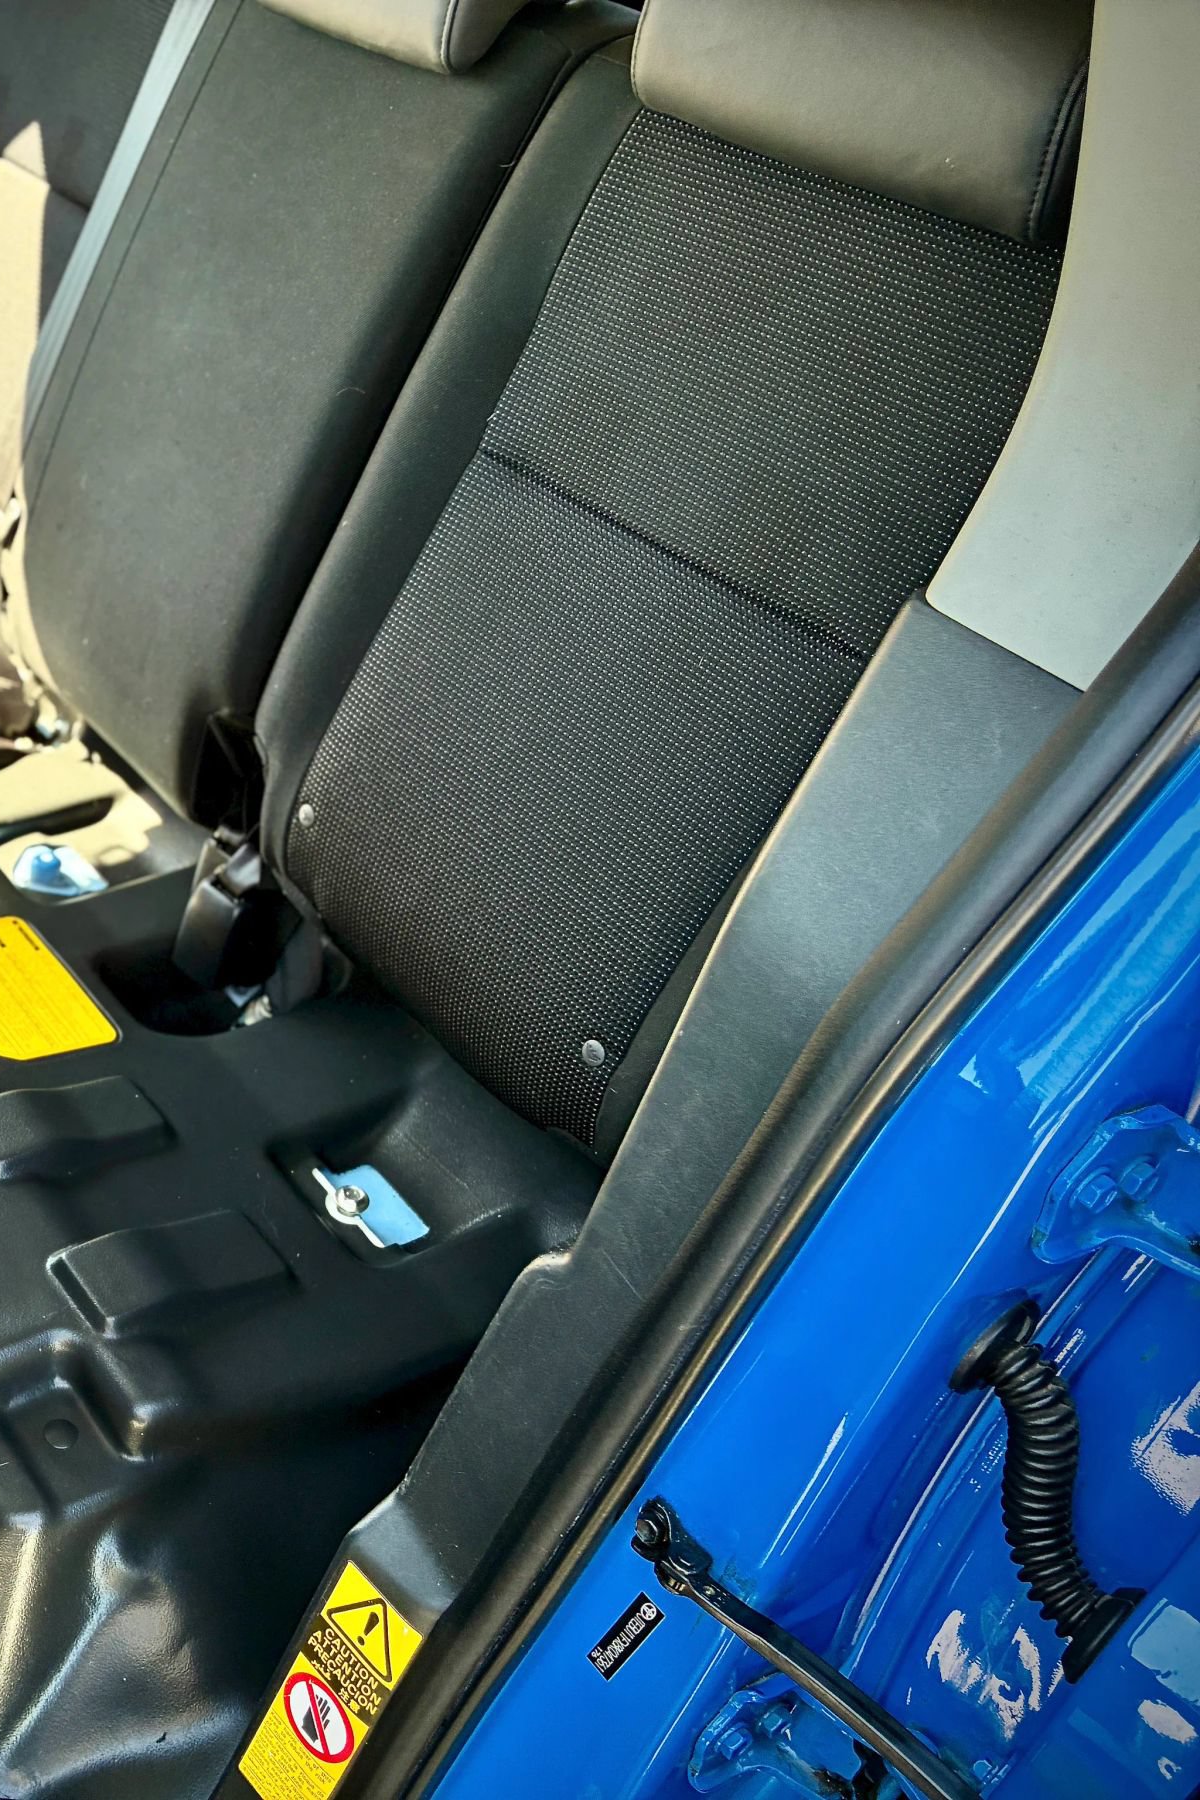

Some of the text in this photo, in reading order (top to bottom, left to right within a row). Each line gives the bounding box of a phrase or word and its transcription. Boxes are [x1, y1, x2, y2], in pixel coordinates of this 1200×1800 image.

[307, 1636, 378, 1715] PRECAUCION
[313, 1630, 382, 1706] ATTENTION
[325, 1628, 379, 1690] CAUTION
